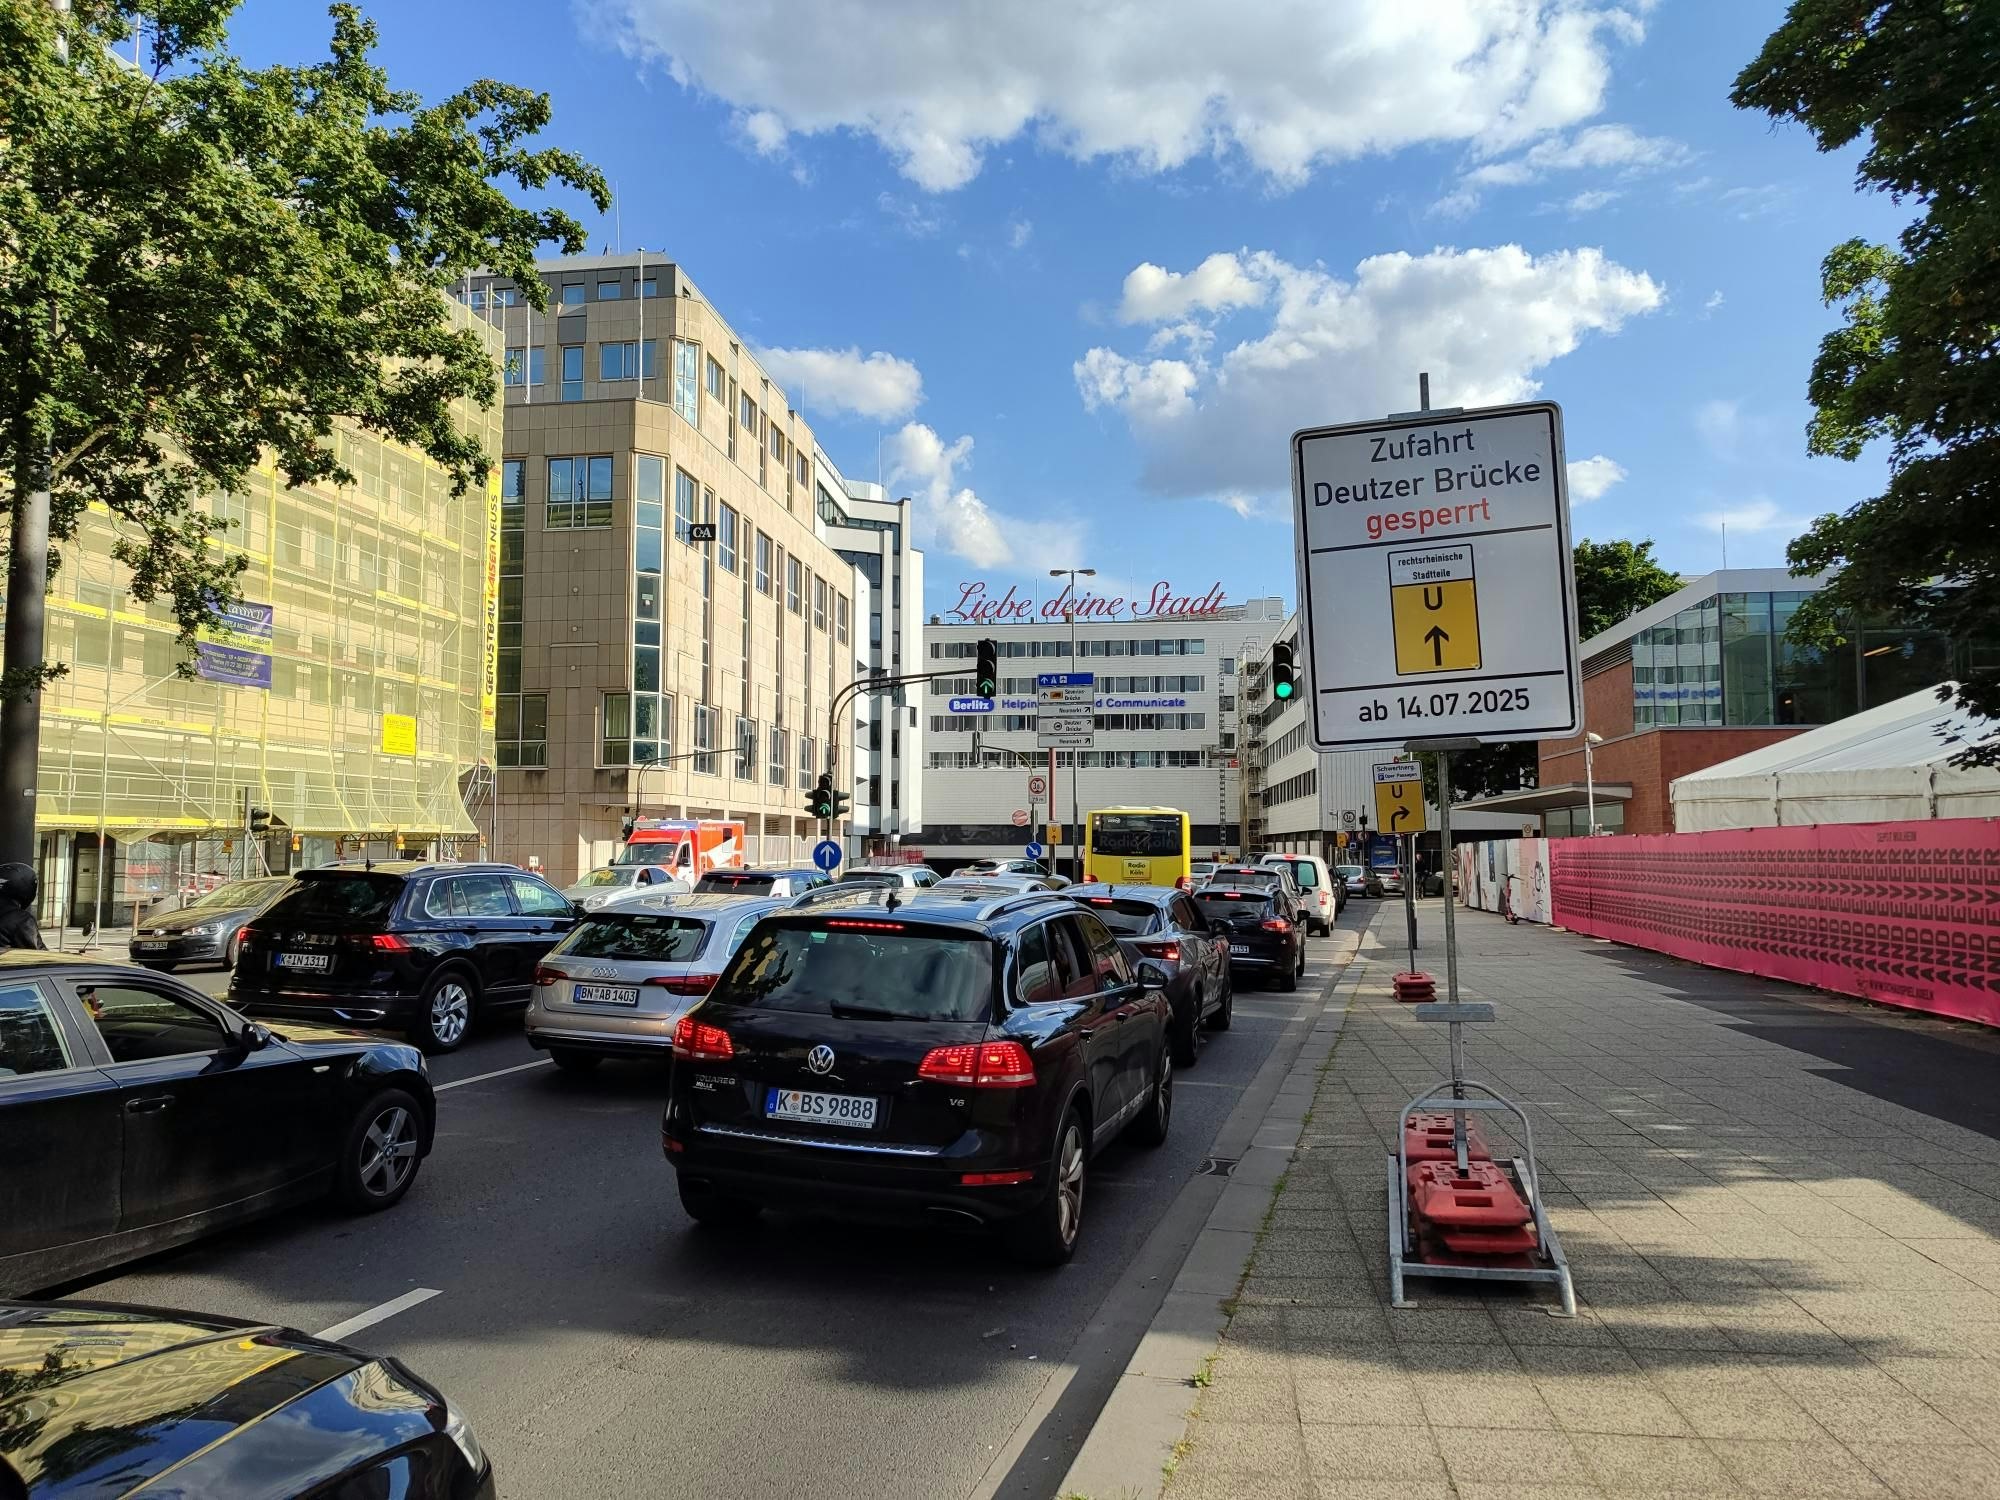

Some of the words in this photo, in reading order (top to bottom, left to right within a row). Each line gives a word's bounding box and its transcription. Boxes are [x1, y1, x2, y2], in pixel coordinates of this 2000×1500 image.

[1369, 428, 1475, 463] Zufahrt
[1313, 475, 1425, 507] Deutzer
[1434, 460, 1541, 494] Brücke
[489, 494, 498, 542] NEUSS
[692, 526, 712, 538] C&A
[1366, 498, 1491, 540] gesperrt
[1397, 552, 1464, 567] rechtsrheinische
[1412, 568, 1451, 581] Stadtteile
[945, 581, 1032, 622] Liebe
[1040, 584, 1124, 618] deine
[1131, 580, 1229, 617] Stadt
[1423, 586, 1443, 610] U
[952, 700, 990, 711] Berlitz
[1106, 698, 1186, 708] Communicate
[1358, 700, 1388, 723] ab
[1397, 688, 1530, 720] 14.07.2025
[1392, 784, 1402, 798] U
[1840, 849, 1850, 912] EVER
[1851, 849, 1862, 914] EVER
[1863, 849, 1874, 915] EVER
[1875, 849, 1889, 916] EVER
[1889, 849, 1902, 918] EVER
[1903, 848, 1917, 919] EVER
[1917, 848, 1933, 920] EVER
[1933, 848, 1950, 922] EVER
[1950, 848, 1966, 923] EVER
[1966, 848, 1984, 925] EVER
[281, 954, 287, 965] K
[304, 956, 326, 967] 1311
[1841, 920, 1851, 967] AND
[1853, 922, 1864, 970] AND
[1865, 923, 1876, 972] AND
[1878, 924, 1890, 975] AND
[1891, 925, 1904, 977] AND
[1905, 926, 1919, 980] AND
[1920, 928, 1934, 982] AND
[1936, 930, 1951, 985] AND
[1952, 931, 1968, 988] AND
[1969, 933, 1985, 992] AND
[581, 988, 593, 999] BN
[599, 988, 611, 1000] AB
[612, 990, 635, 1002] 1403
[778, 1091, 791, 1111] K
[800, 1095, 825, 1114] BS
[829, 1098, 873, 1120] 9888
[950, 1098, 965, 1106] V6
